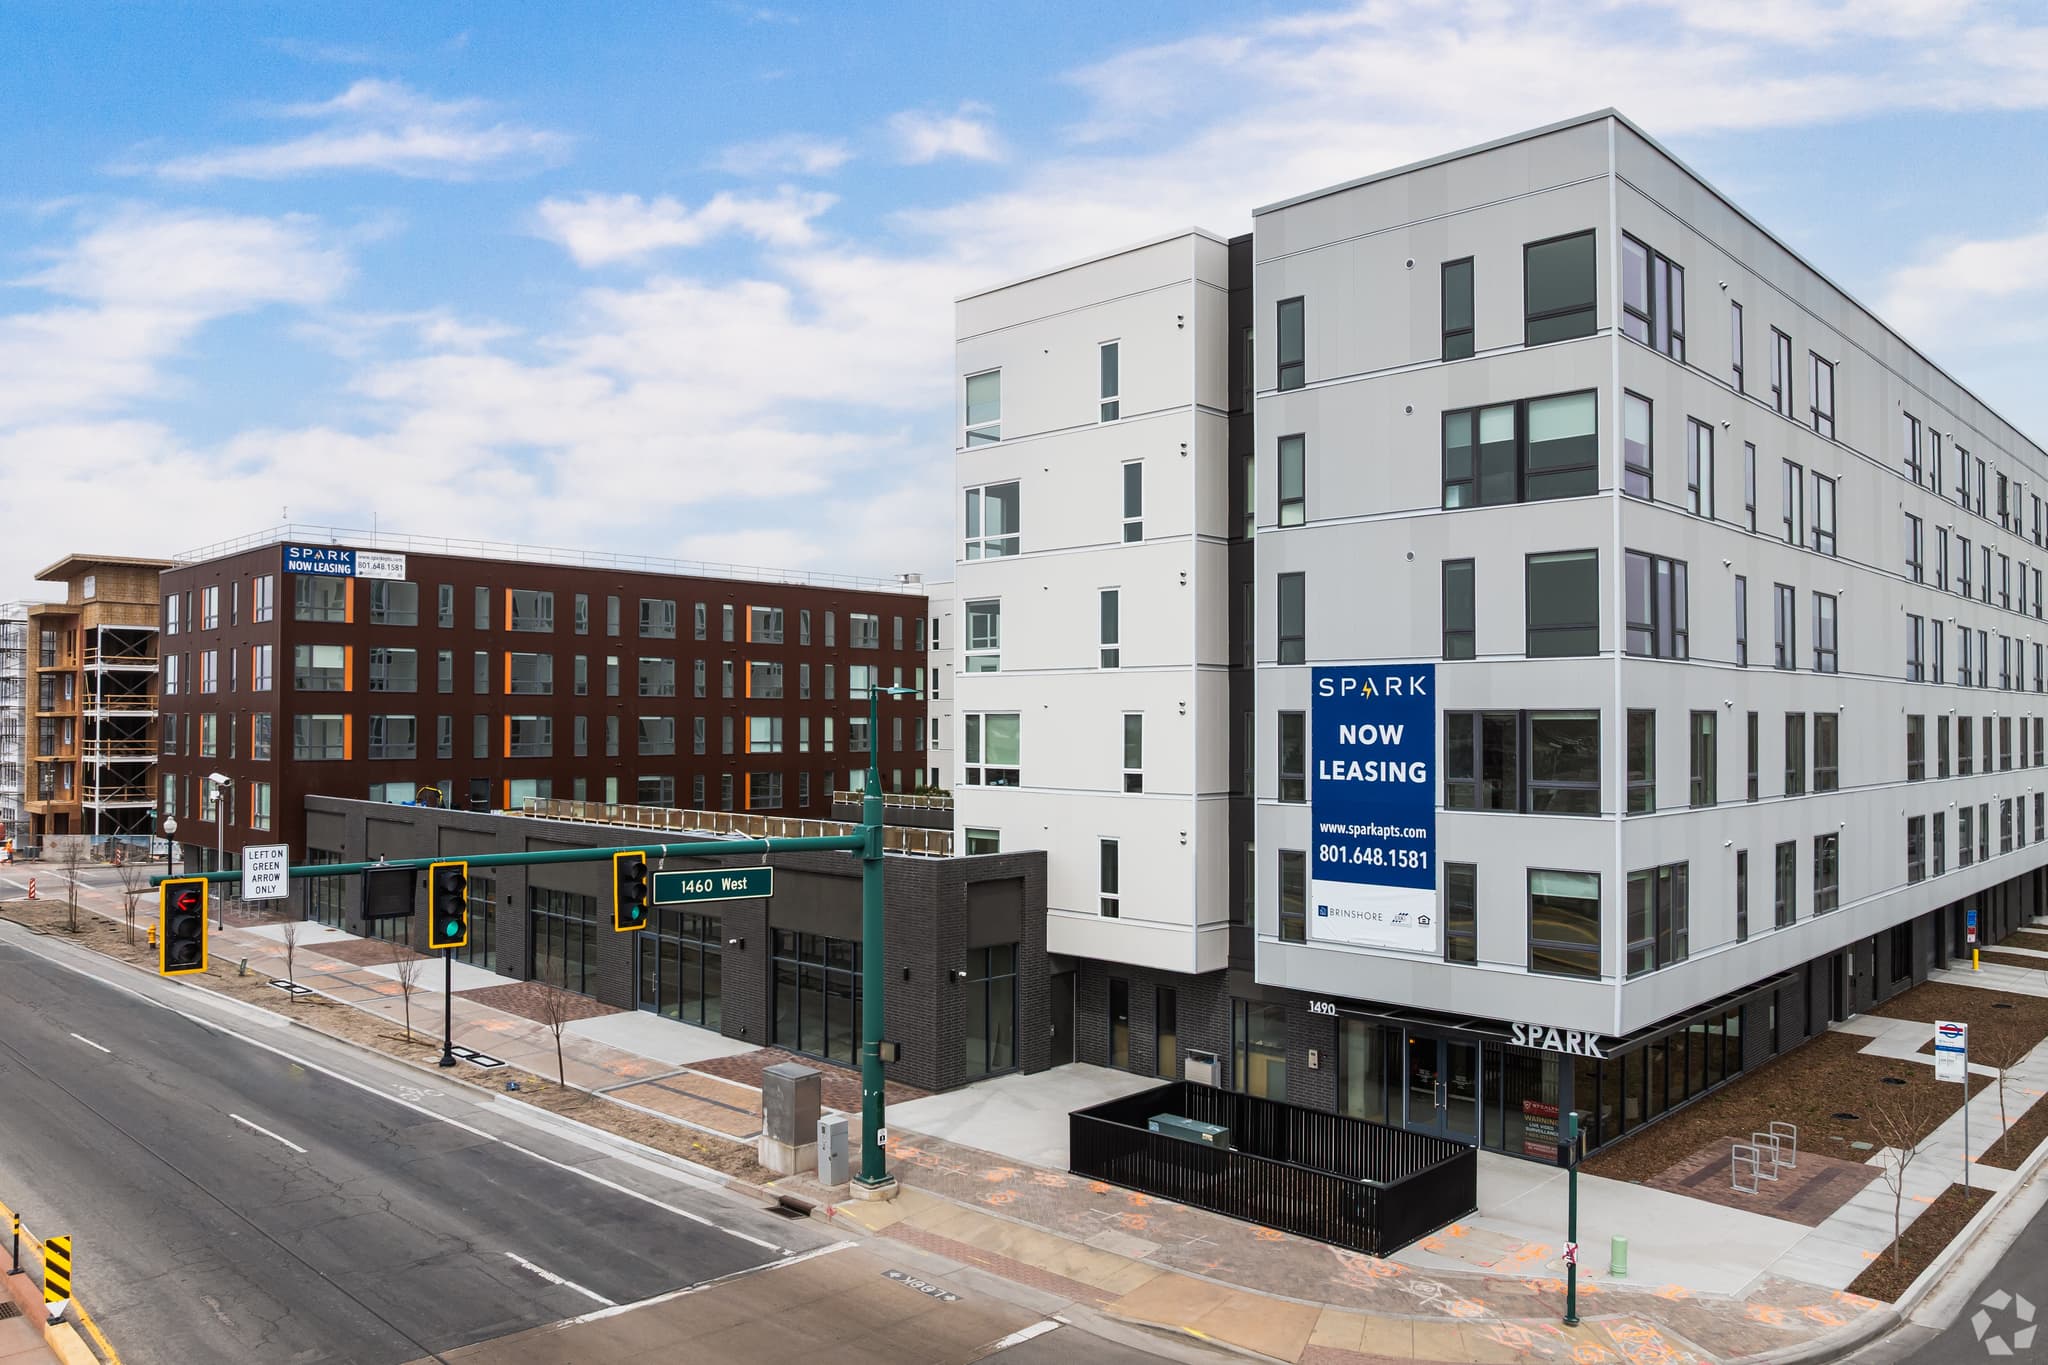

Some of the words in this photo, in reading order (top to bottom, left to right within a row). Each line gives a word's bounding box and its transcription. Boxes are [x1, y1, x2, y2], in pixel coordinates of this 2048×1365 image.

[289, 547, 350, 562] SPARK
[288, 560, 313, 572] NOW
[314, 562, 351, 574] LEASING
[358, 561, 403, 572] 801.648.1581
[1319, 676, 1427, 699] SPARK
[1339, 724, 1405, 745] NOW
[1319, 760, 1427, 783] LEASING
[1319, 822, 1427, 840] www.sparkapts.com
[249, 850, 269, 859] LEFT
[271, 849, 283, 858] ON
[1319, 844, 1428, 870] 801.648.1581
[252, 861, 280, 871] GREEN
[252, 873, 280, 882] ARROW
[255, 885, 276, 894] ONLY
[681, 879, 713, 894] 1460
[721, 877, 748, 891] West
[1329, 907, 1383, 922] BRINSHORE
[1309, 1000, 1335, 1015] 1490
[1511, 1022, 1604, 1058] SPARK
[900, 1275, 947, 1296] LOOK
